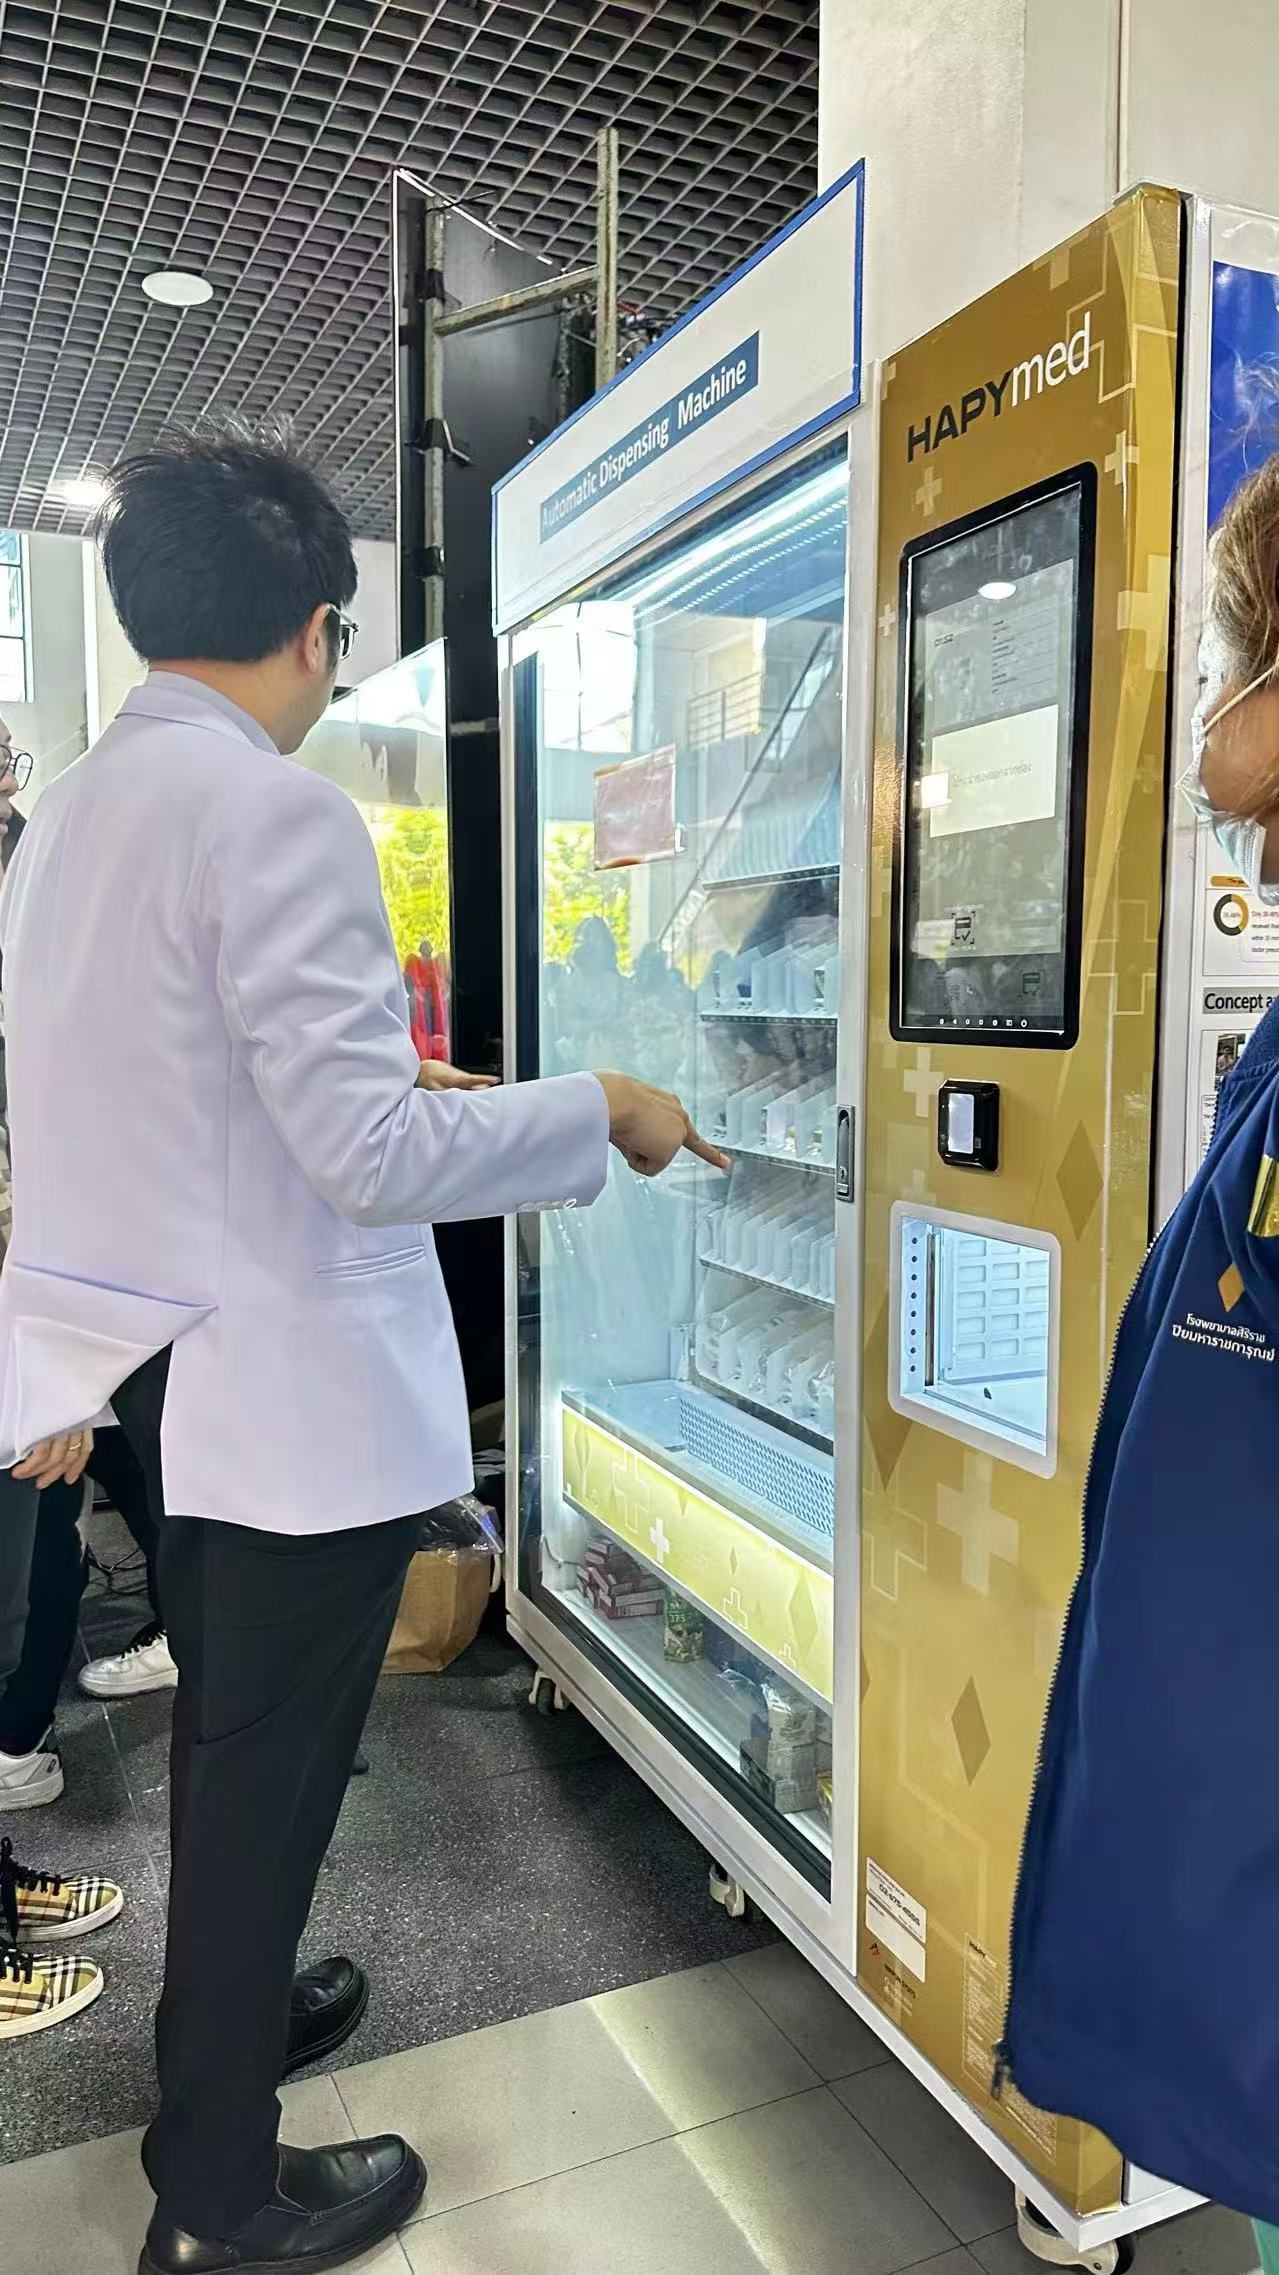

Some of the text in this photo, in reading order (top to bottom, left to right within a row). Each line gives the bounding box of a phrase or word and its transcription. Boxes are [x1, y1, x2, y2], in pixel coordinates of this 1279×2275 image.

[907, 311, 1091, 463] HAPYmed
[542, 359, 747, 527] Automatic Dispensing Machine
[1204, 993, 1264, 1013] Concept
[1186, 1313, 1265, 1343] โรงพยาบาลศิริราช
[669, 1614, 686, 1623] 375
